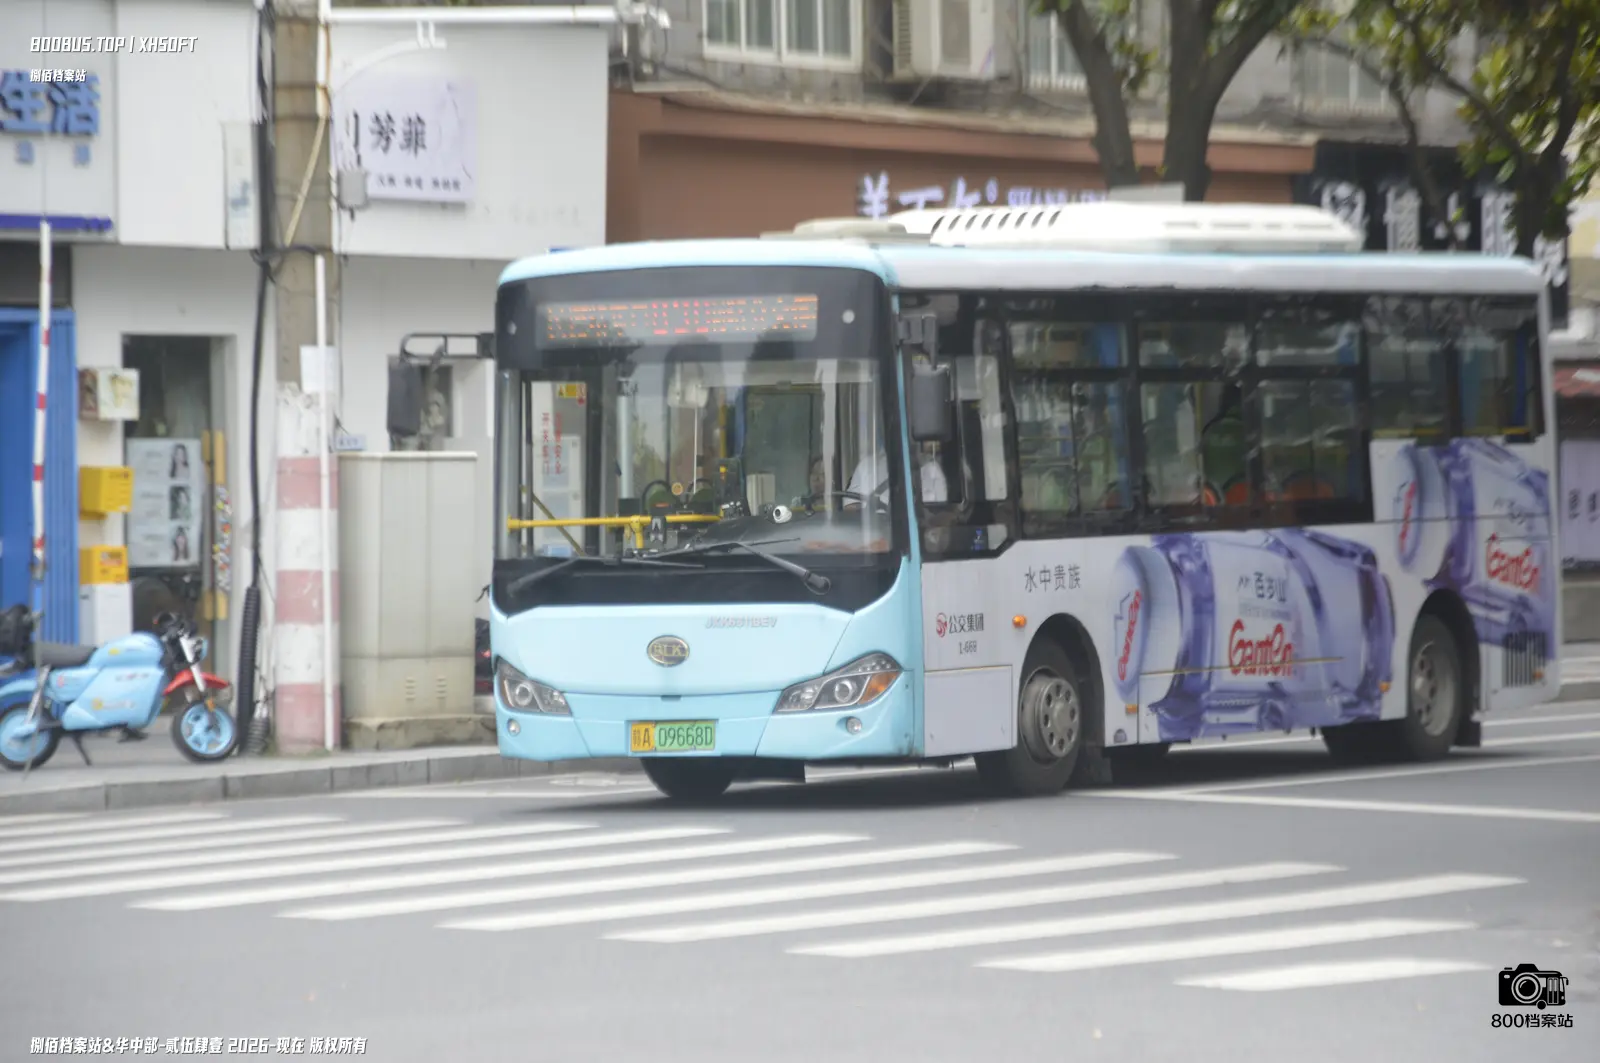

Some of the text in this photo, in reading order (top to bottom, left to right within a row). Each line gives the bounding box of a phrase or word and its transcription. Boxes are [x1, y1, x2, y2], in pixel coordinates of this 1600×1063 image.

[1024, 564, 1082, 593] 水中贵族
[948, 612, 984, 634] 公交集团
